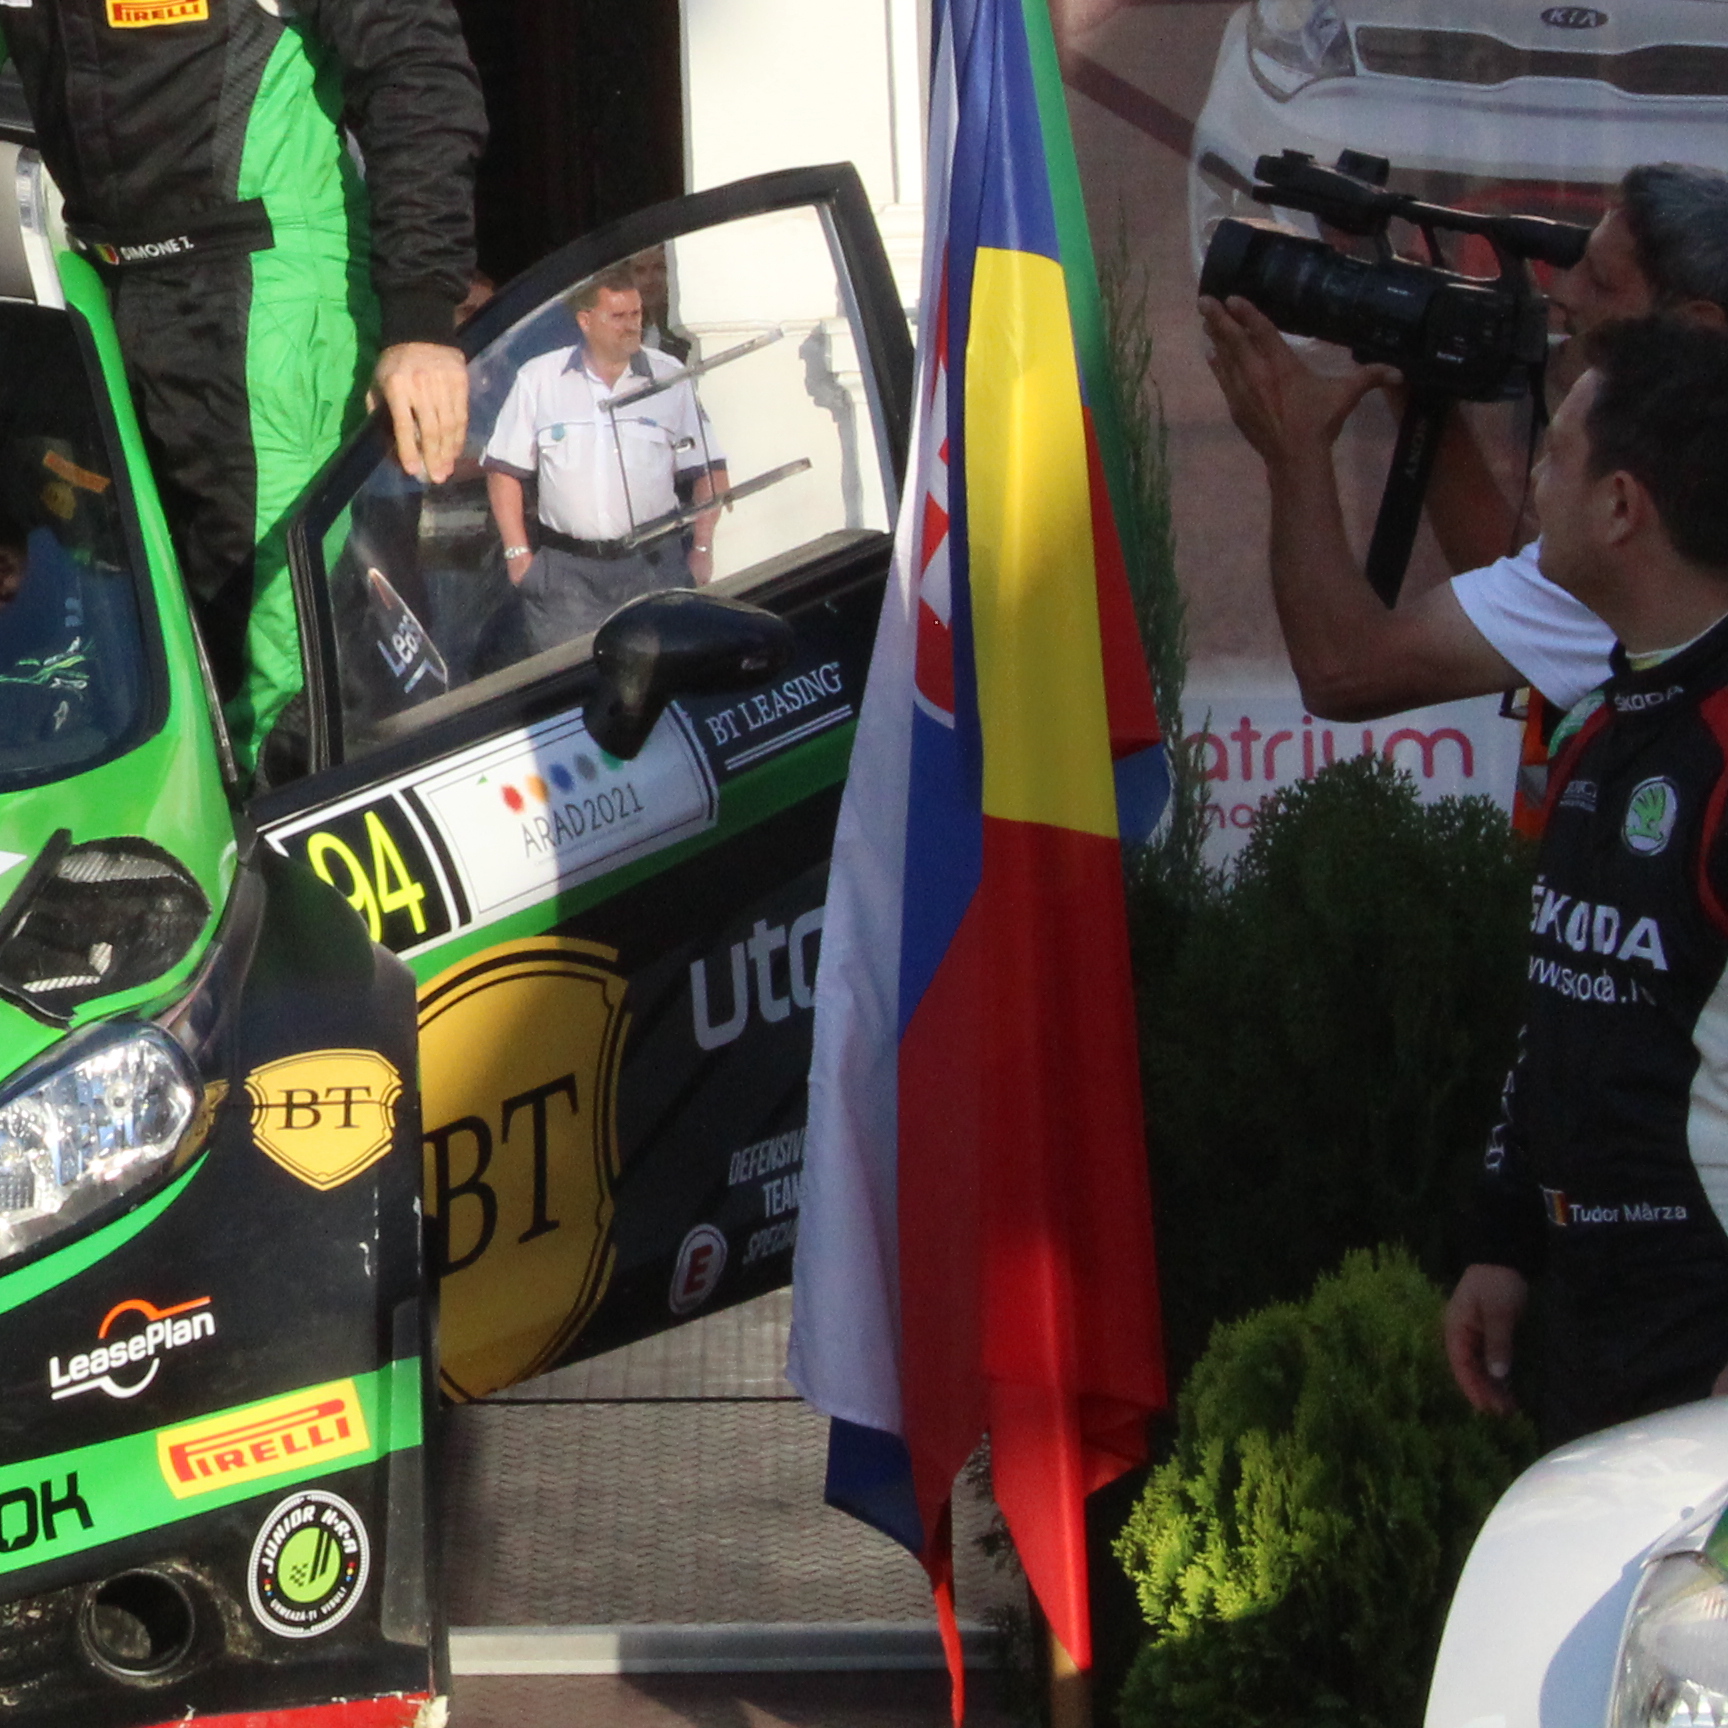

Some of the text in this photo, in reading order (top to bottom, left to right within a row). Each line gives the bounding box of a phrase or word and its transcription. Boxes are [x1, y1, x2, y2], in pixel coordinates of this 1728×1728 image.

[119, 237, 182, 262] SIMONE
[704, 662, 842, 747] BT LEASING
[519, 781, 644, 860] ARAD2021
[276, 1085, 372, 1131] BT
[422, 1073, 581, 1280] BT
[1570, 1202, 1620, 1224] Tudor
[683, 1244, 714, 1297] E
[48, 1310, 216, 1389] LeasePlan
[168, 1397, 353, 1483] PIRELLI
[260, 1504, 317, 1575] JUNIOR
